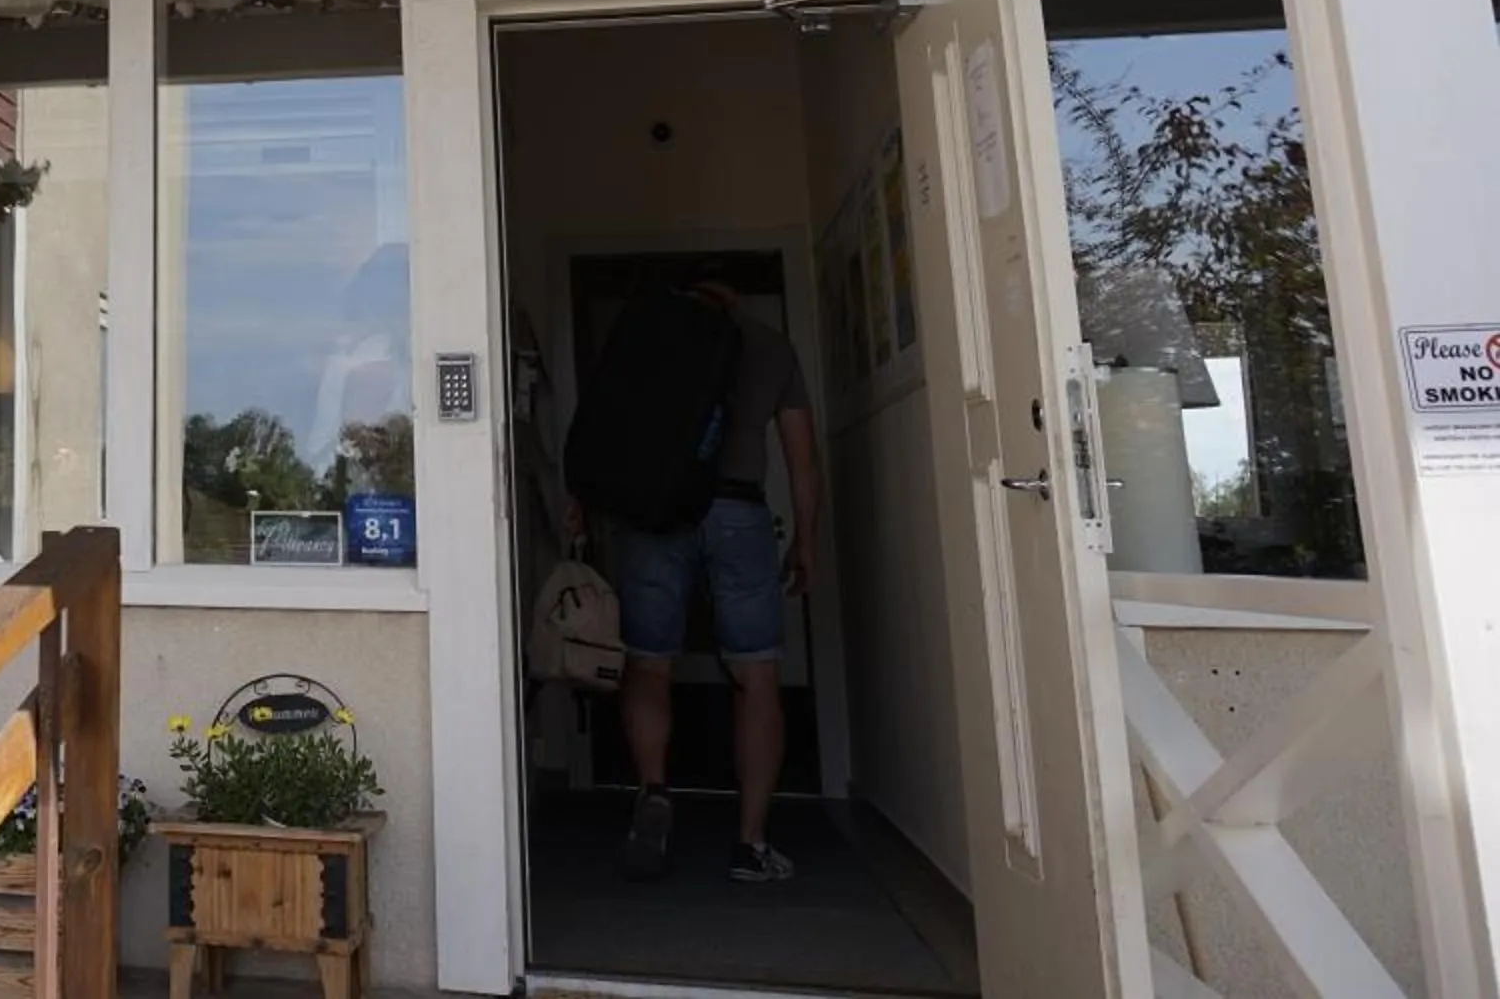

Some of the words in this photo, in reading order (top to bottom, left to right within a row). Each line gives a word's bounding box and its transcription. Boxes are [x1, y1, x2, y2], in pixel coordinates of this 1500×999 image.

[1414, 336, 1483, 360] Please
[1459, 365, 1494, 382] NO
[364, 517, 401, 542] 8,1
